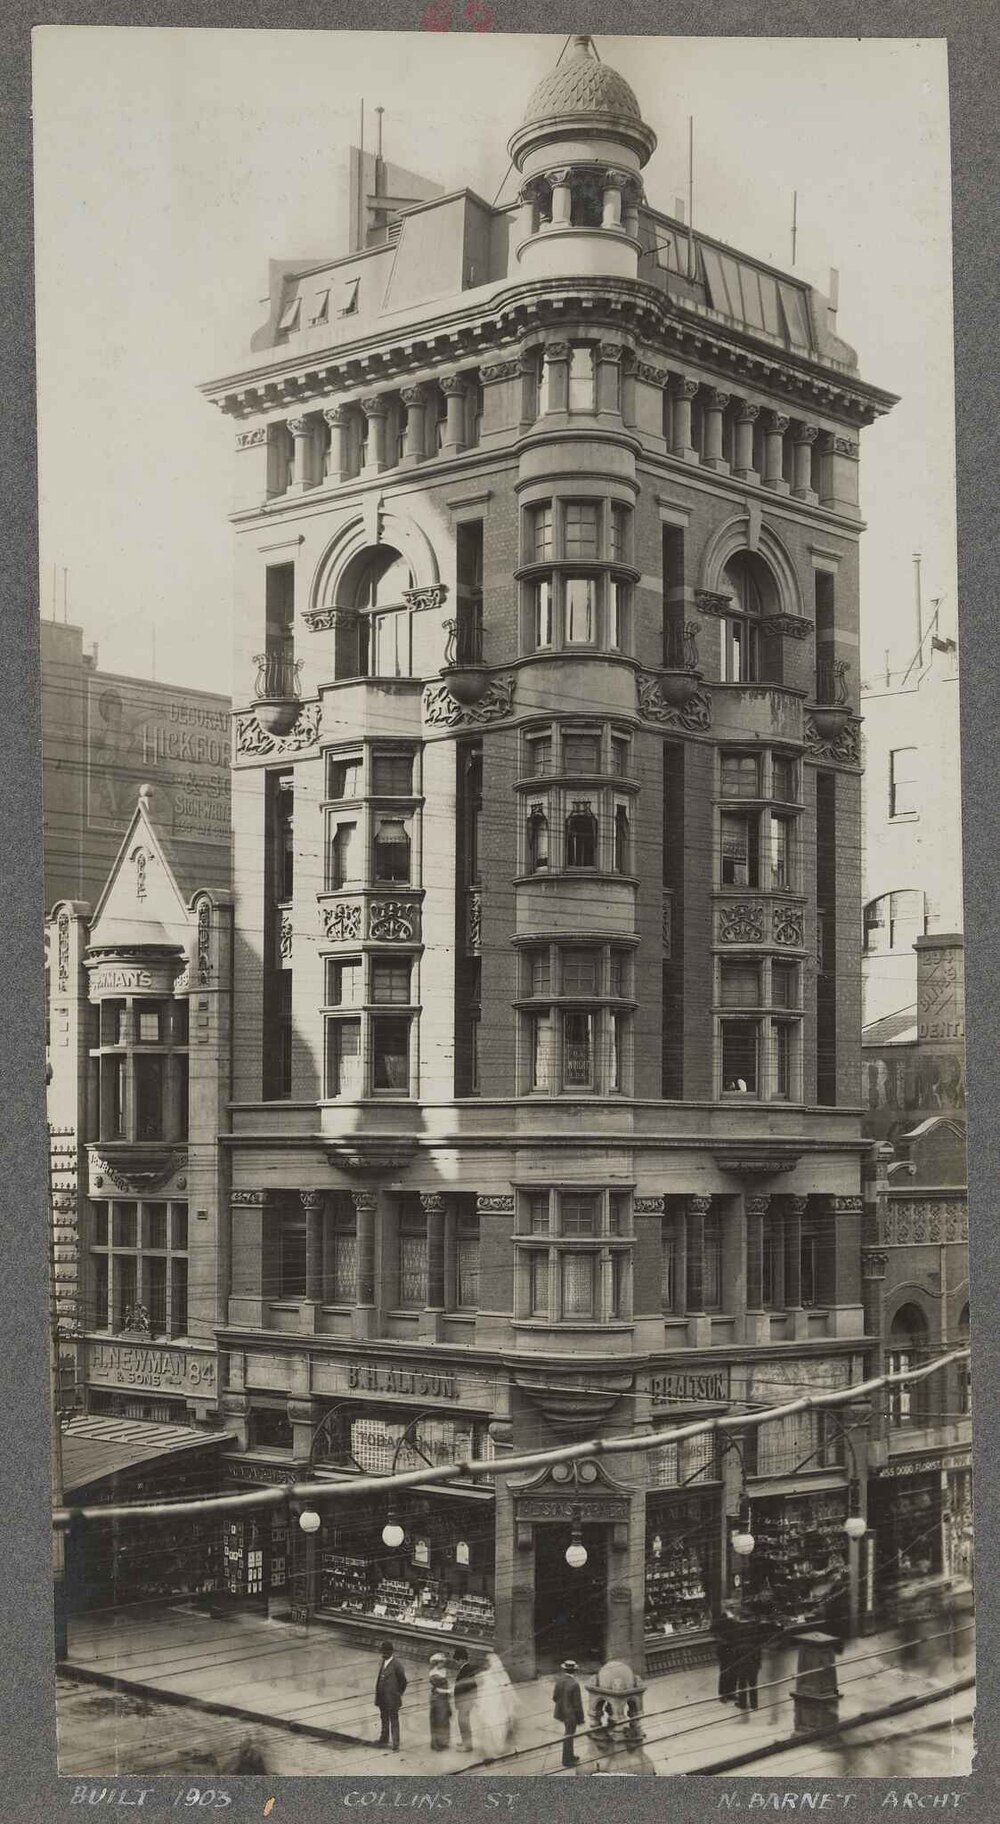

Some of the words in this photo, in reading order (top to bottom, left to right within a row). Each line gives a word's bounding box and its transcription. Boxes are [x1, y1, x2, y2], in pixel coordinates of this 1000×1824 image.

[127, 1373, 161, 1387] SONS
[188, 1361, 216, 1387] 84
[69, 1784, 154, 1806] BUILT
[172, 1786, 233, 1808] 1903
[343, 1790, 453, 1810] COLLINS
